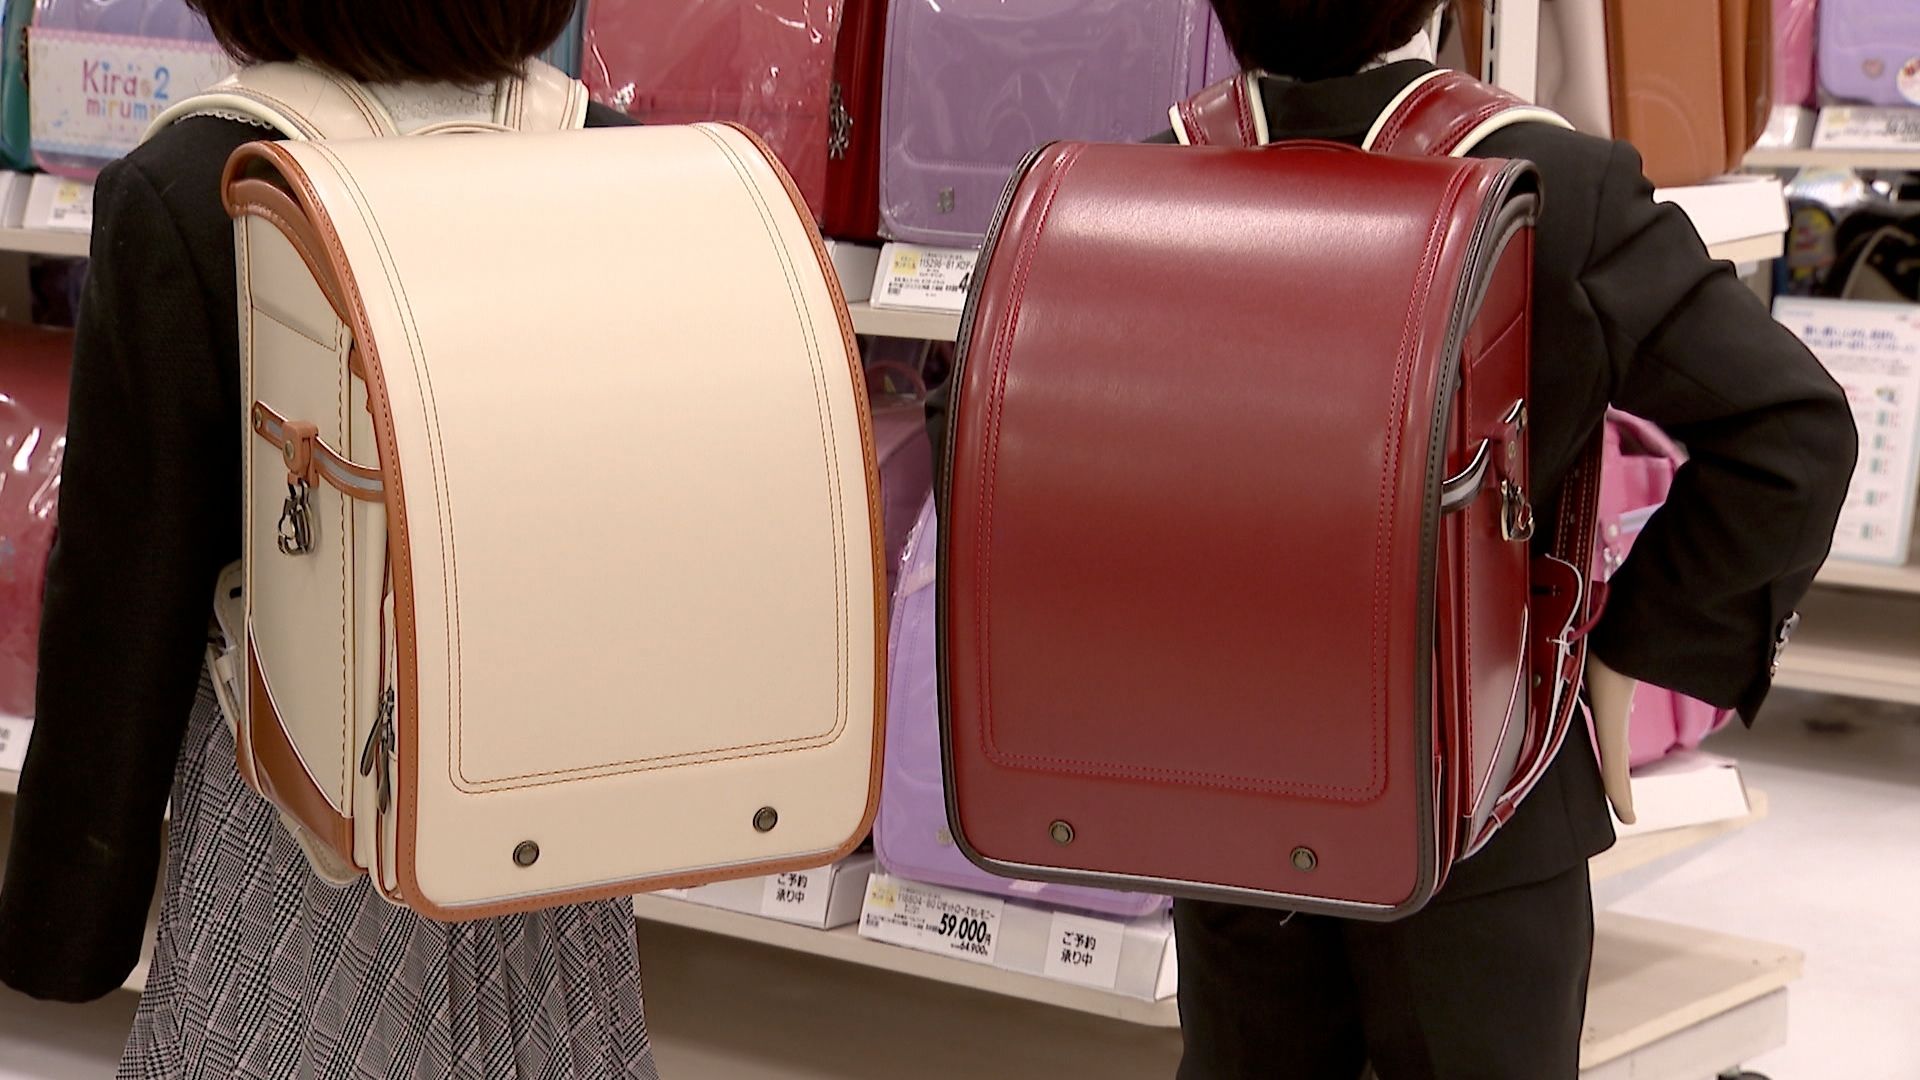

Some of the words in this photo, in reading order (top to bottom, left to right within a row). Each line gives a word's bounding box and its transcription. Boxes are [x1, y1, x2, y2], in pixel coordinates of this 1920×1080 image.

[776, 887, 805, 904] 承り中
[1062, 931, 1096, 950] ご予約
[1061, 948, 1093, 967] 承り中
